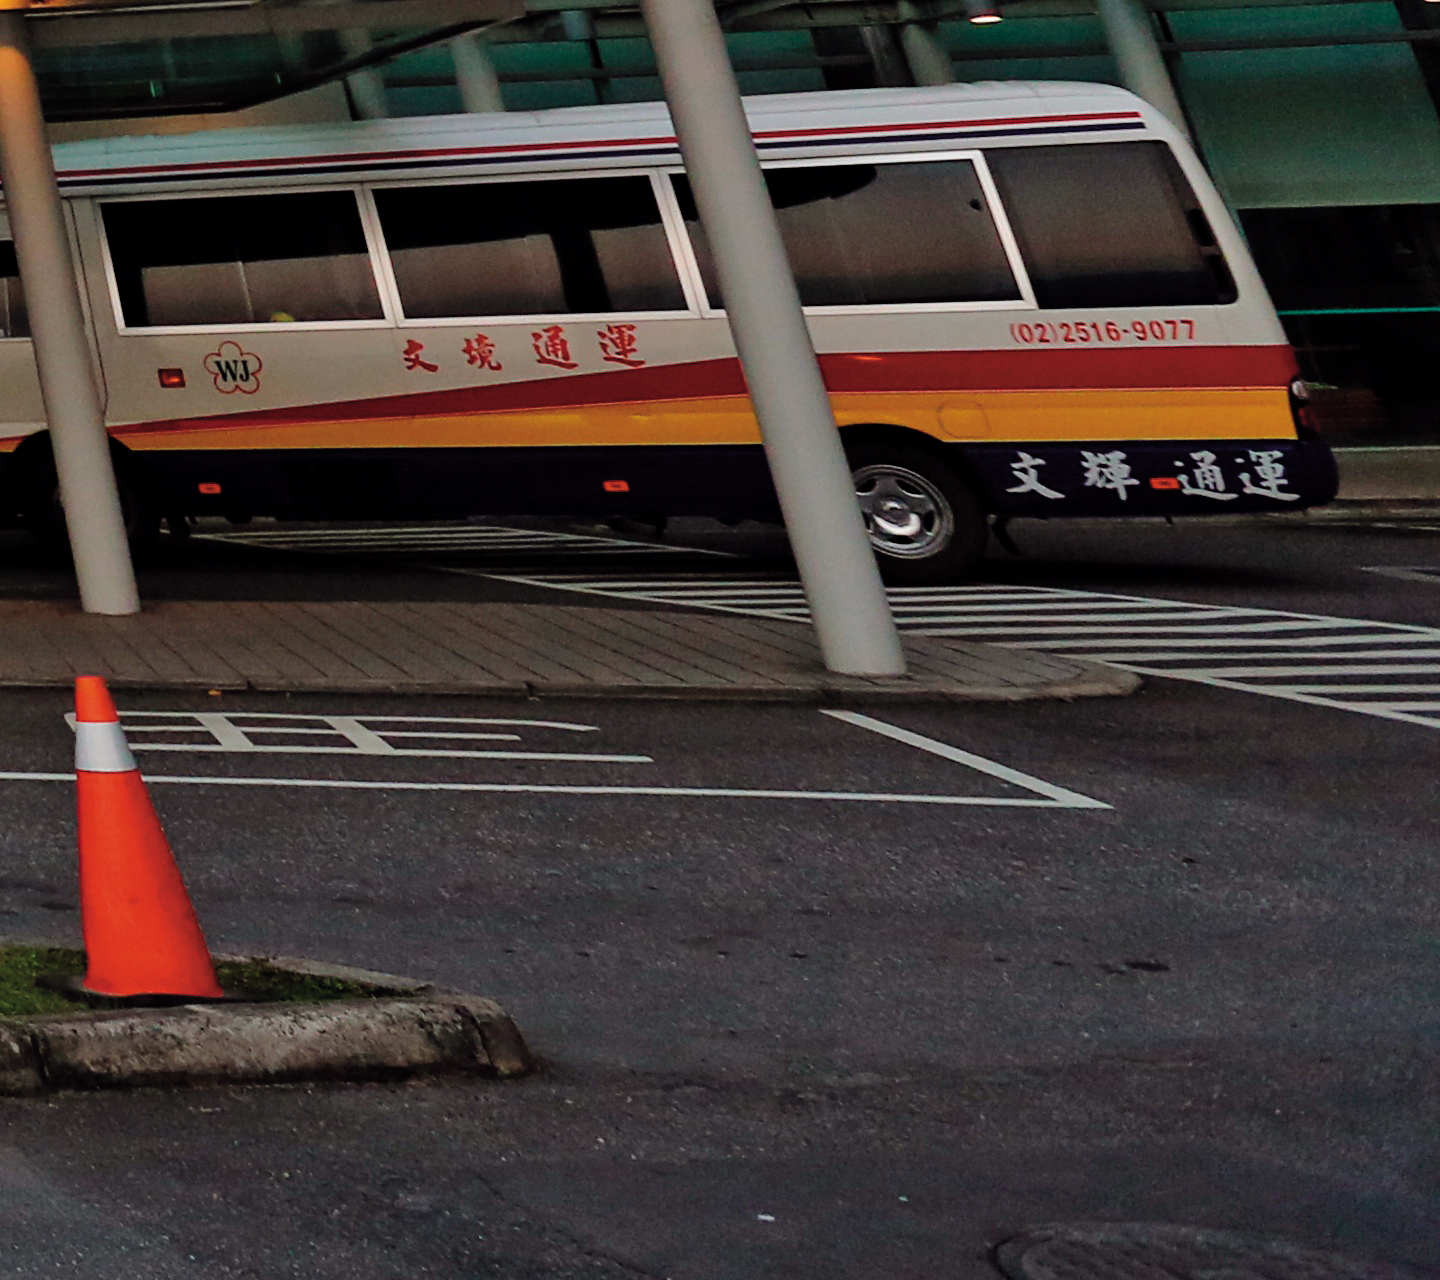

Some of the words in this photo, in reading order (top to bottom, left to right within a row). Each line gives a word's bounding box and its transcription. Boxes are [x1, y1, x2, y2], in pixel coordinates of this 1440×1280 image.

[402, 323, 647, 374] 文境通運
[1010, 319, 1195, 343] (02)2516-9077
[213, 358, 251, 383] WJ
[1005, 449, 1301, 501] 文輝通運
